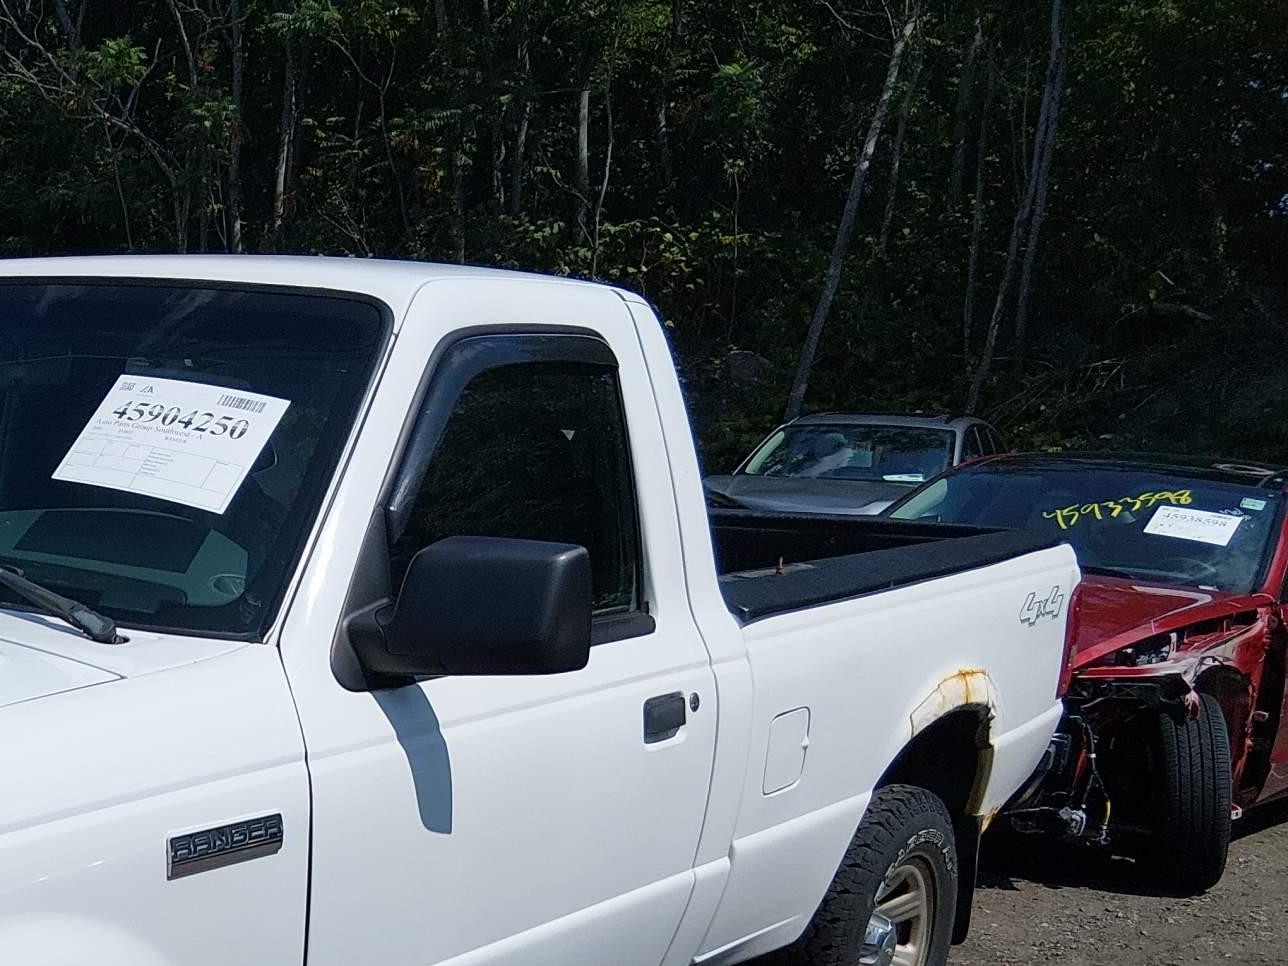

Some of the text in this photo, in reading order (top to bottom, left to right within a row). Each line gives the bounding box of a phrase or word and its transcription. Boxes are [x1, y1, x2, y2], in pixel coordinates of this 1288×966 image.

[96, 418, 113, 426] Auto
[112, 420, 131, 429] Parts
[130, 421, 154, 433] Group
[154, 425, 191, 438] Southwest
[112, 400, 251, 440] 45904250
[1162, 512, 1228, 528] 45938598
[1019, 585, 1065, 627] 4x4
[172, 819, 283, 862] RANGER
